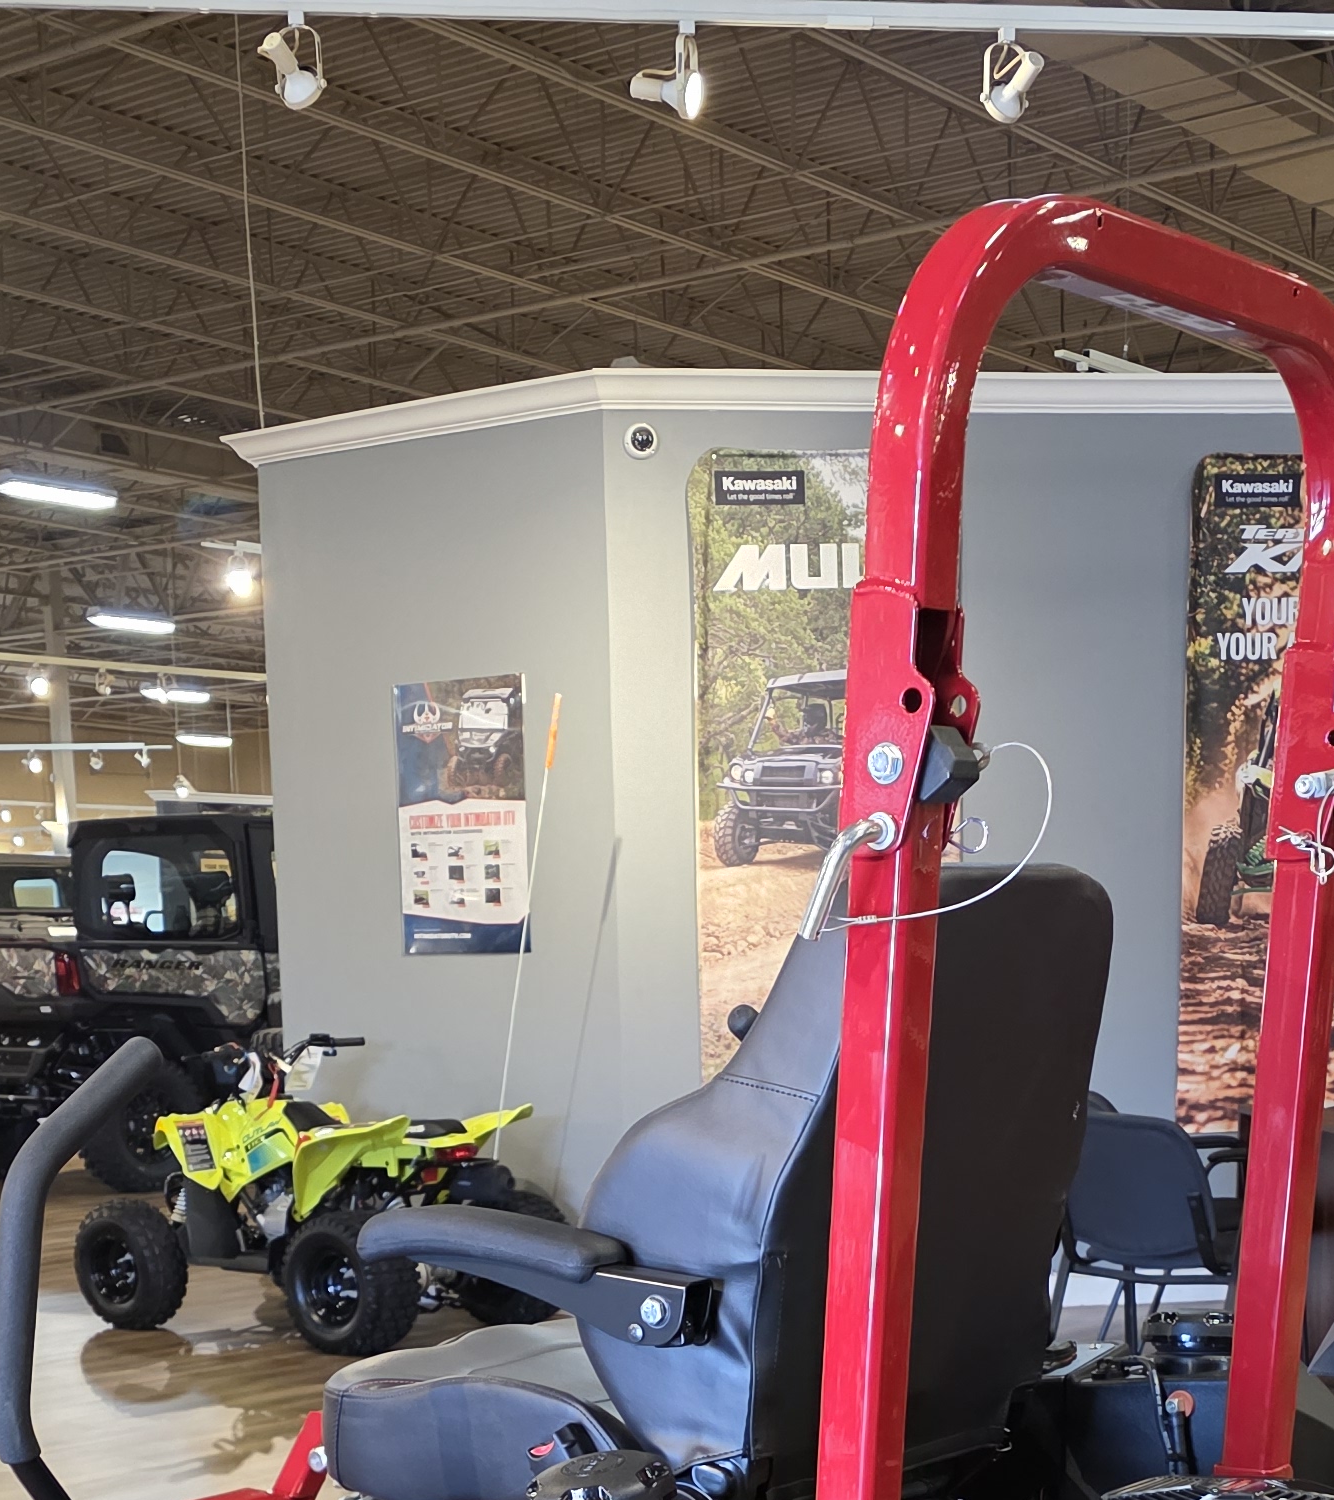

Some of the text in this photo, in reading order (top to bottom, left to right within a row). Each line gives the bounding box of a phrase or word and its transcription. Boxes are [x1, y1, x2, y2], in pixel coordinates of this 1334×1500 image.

[722, 476, 797, 491] Kawasaki
[1221, 479, 1294, 494] Kawasaki
[749, 493, 765, 502] good
[1242, 597, 1300, 626] YOUR
[1217, 632, 1278, 660] YOUR
[112, 960, 204, 970] RANGER
